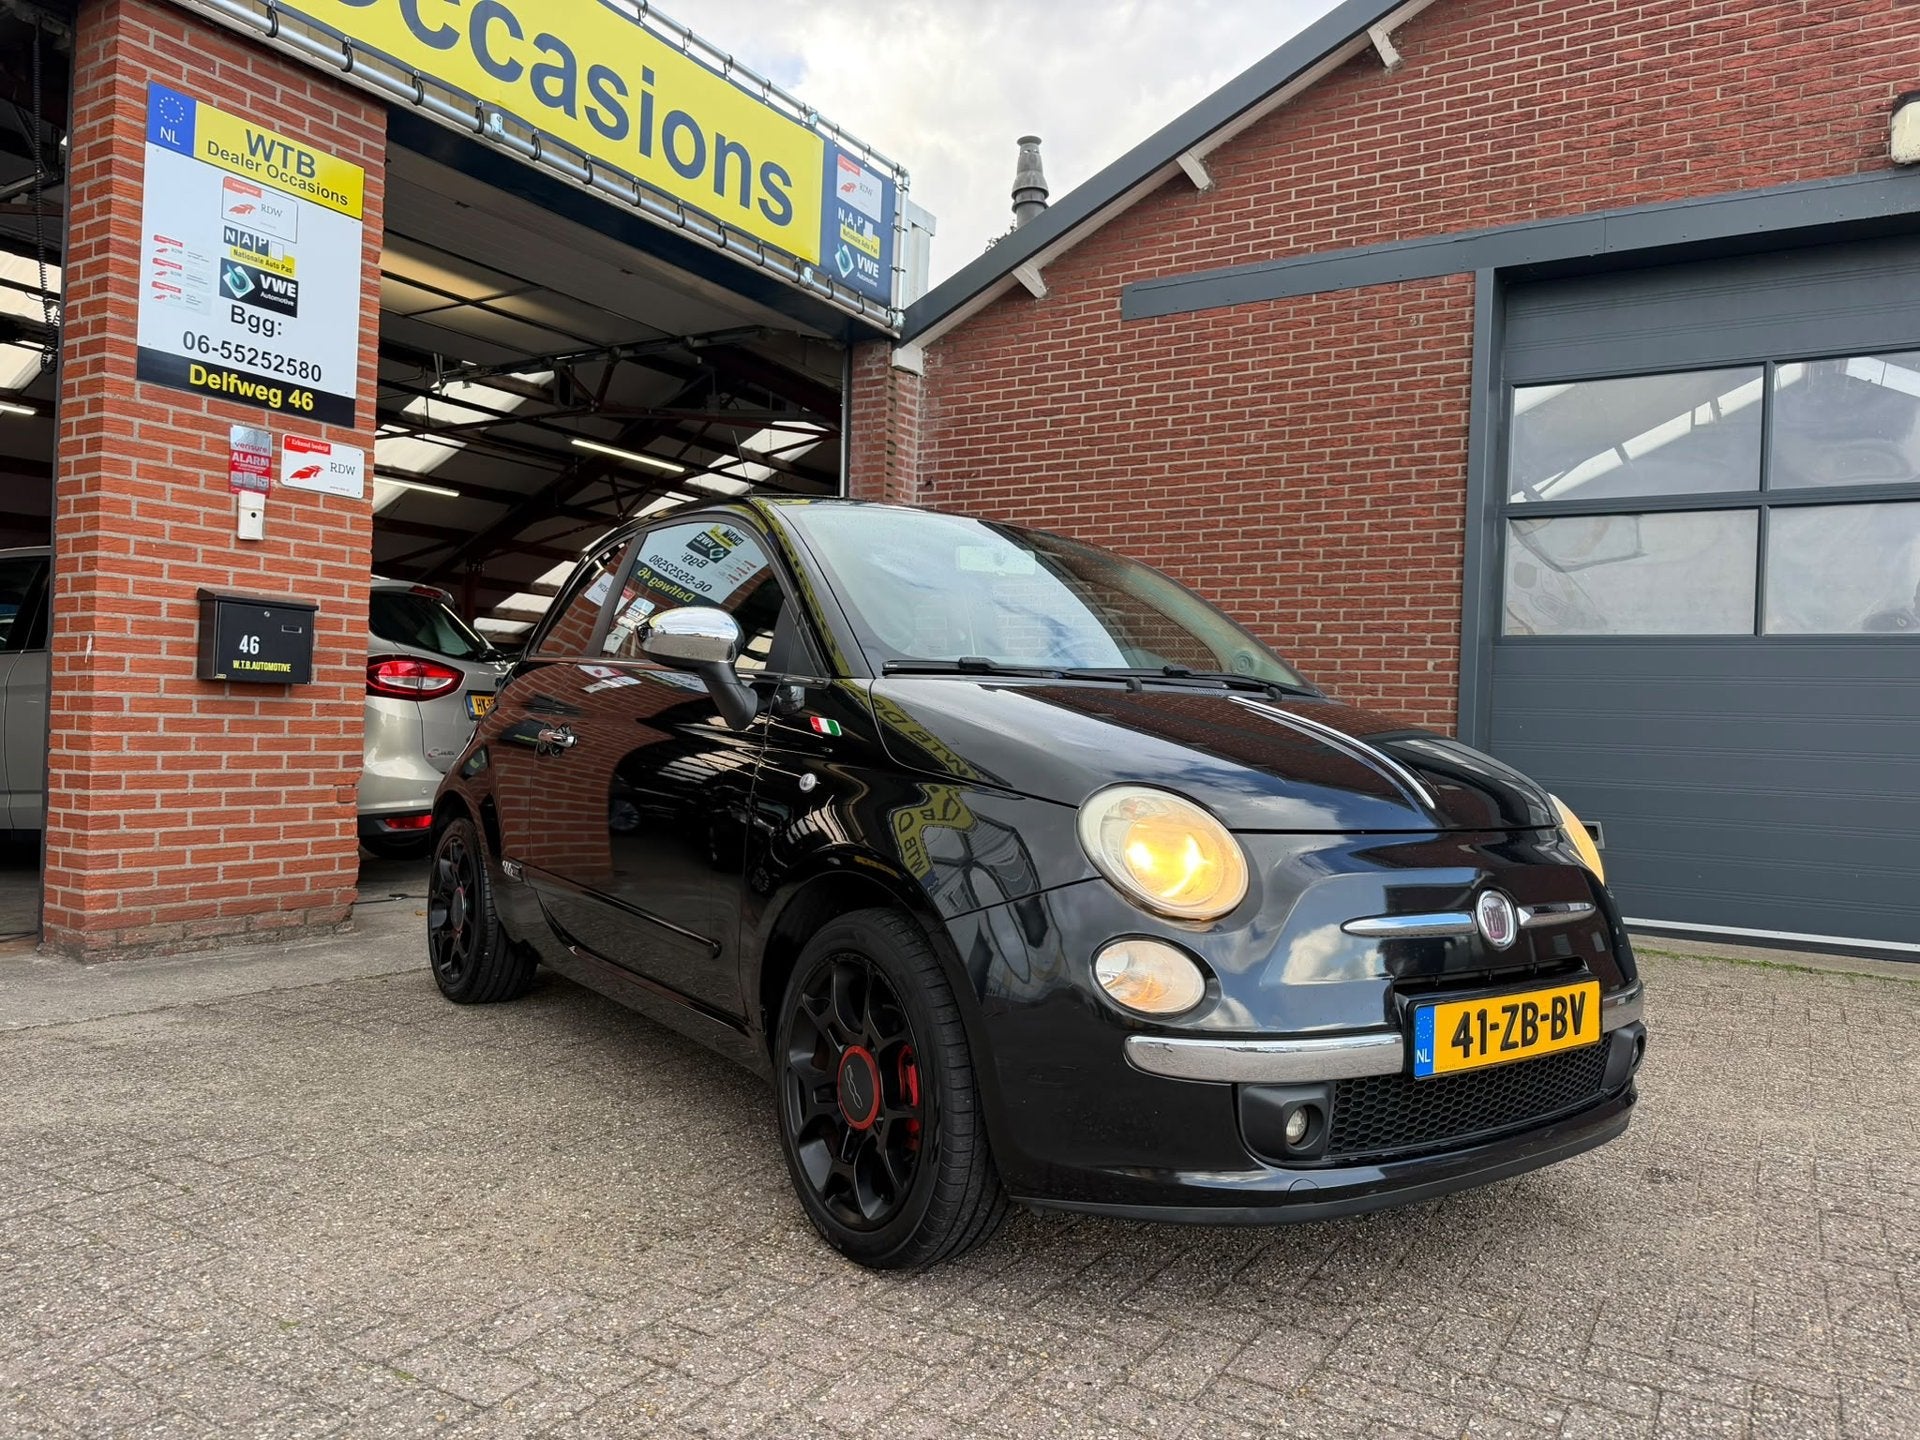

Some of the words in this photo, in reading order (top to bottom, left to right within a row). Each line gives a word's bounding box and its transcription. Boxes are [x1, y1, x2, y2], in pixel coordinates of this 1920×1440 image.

[337, 0, 794, 227] ccasions
[160, 126, 181, 146] NL
[245, 128, 316, 180] WTB
[207, 140, 262, 173] Dealer
[266, 163, 349, 206] Occasions
[261, 203, 283, 218] RDW
[265, 259, 280, 270] Auto
[280, 263, 293, 274] Pas
[856, 253, 879, 279] VWE
[260, 273, 297, 298] VWE
[260, 291, 295, 307] Automotive
[230, 304, 282, 338] Bgg:
[183, 330, 322, 382] 06-55252580
[189, 363, 283, 408] Delfweg
[288, 389, 314, 411] 46
[231, 451, 270, 468] ALARM
[329, 461, 356, 476] RDW
[239, 634, 260, 655] 46
[1450, 990, 1587, 1059] 41-ZB-BV
[1416, 1049, 1431, 1064] NL
